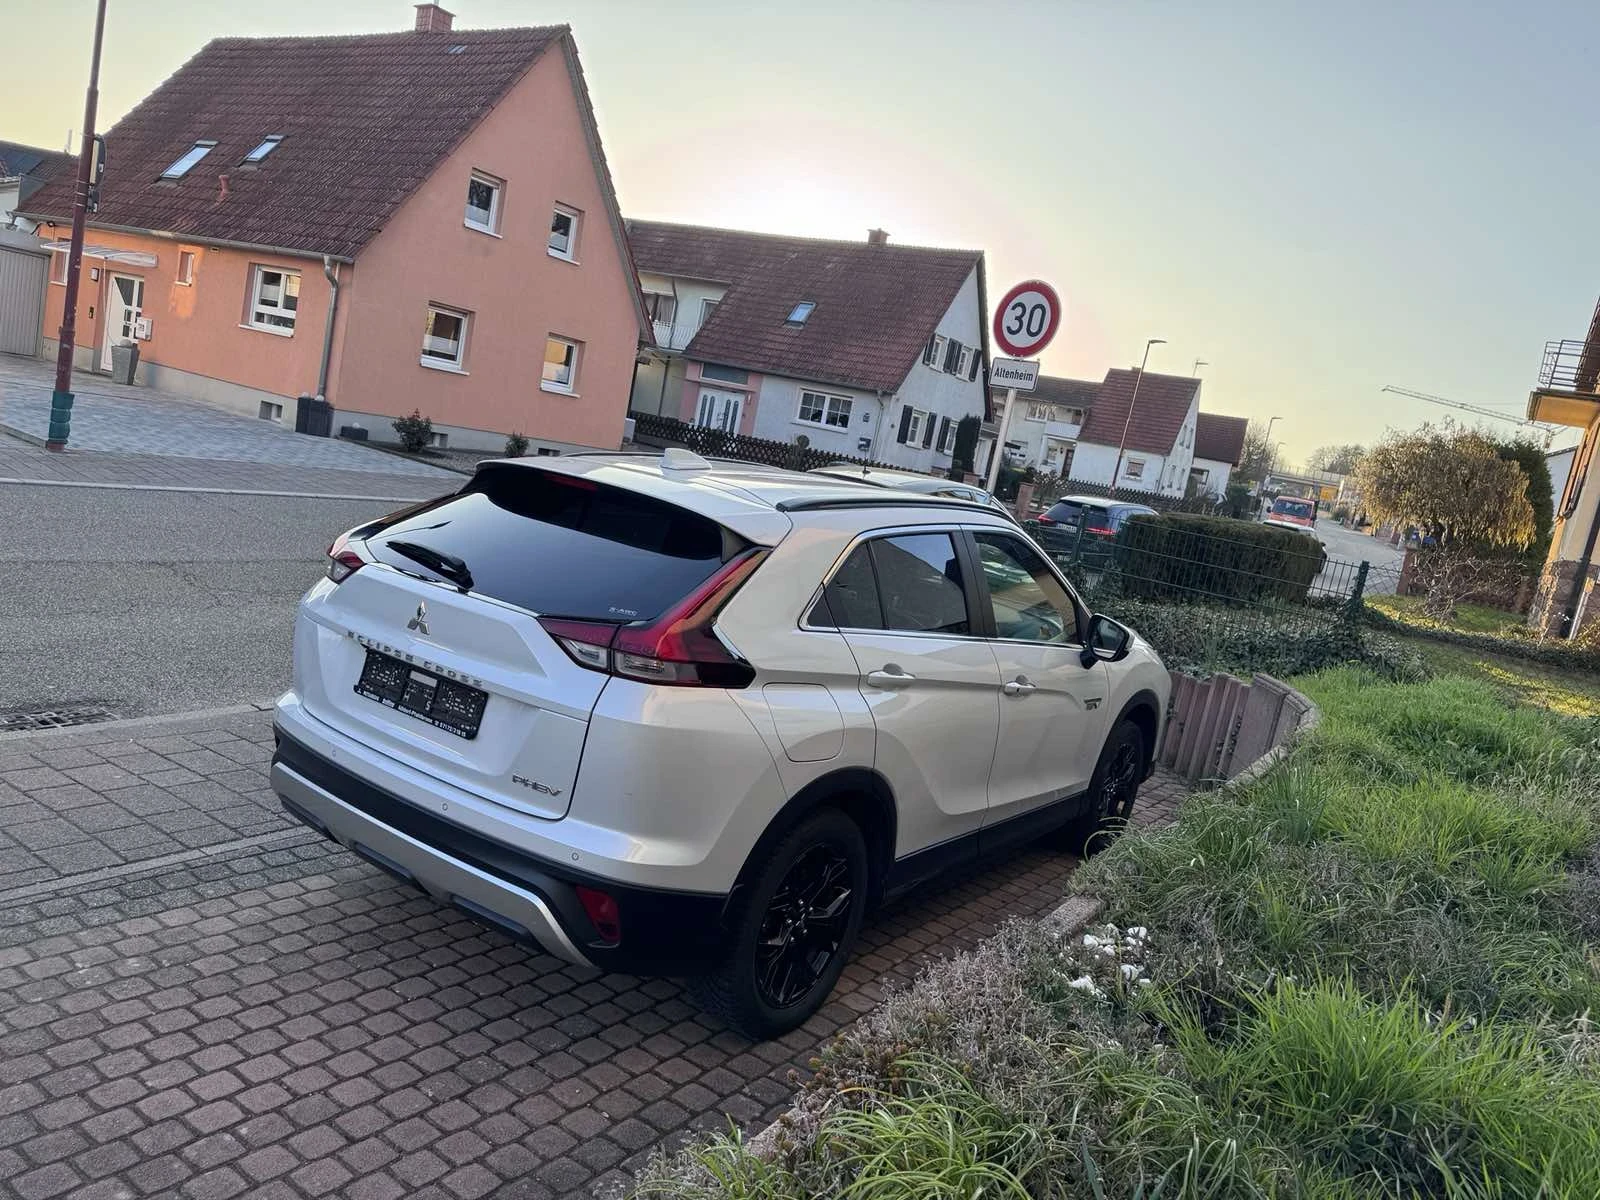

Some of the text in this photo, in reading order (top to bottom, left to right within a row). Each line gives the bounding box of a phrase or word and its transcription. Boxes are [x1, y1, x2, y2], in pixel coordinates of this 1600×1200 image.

[1006, 302, 1046, 337] 30
[994, 367, 1033, 381] Altenheim
[423, 660, 483, 687] CROSS
[512, 774, 562, 797] PHEV
